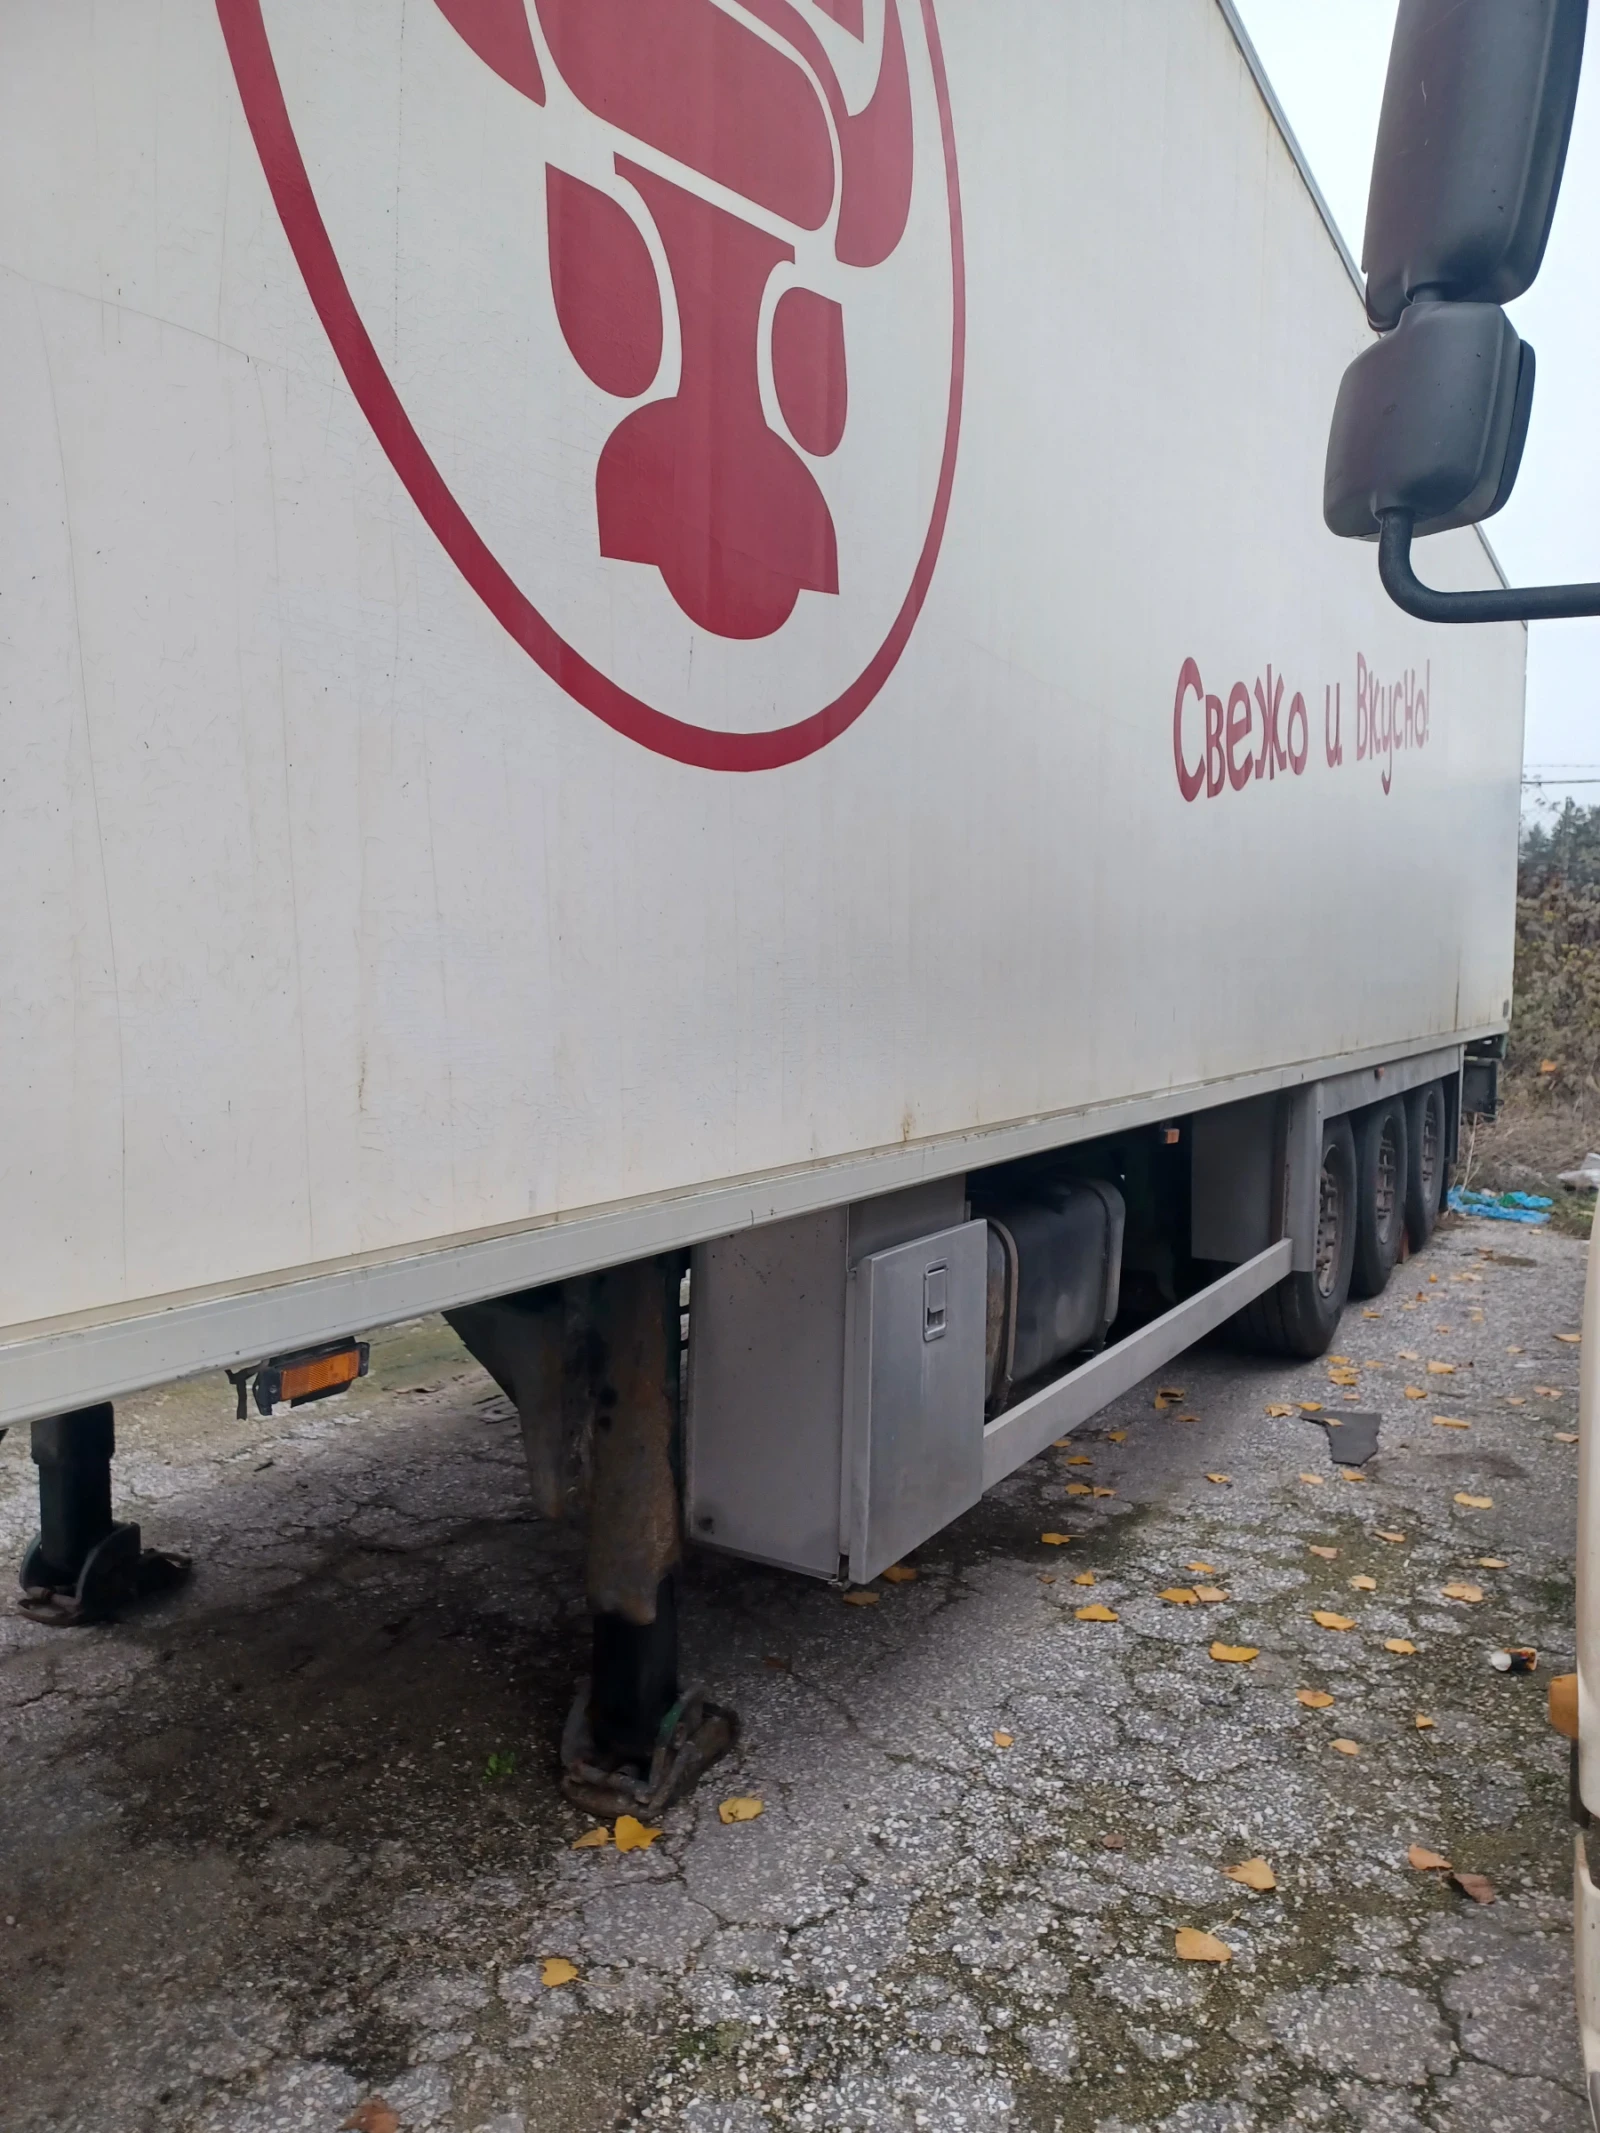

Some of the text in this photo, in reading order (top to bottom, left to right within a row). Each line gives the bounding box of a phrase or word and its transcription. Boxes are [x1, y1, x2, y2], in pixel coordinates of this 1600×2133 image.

[1173, 651, 1430, 802] Свежо и Вкусно!
